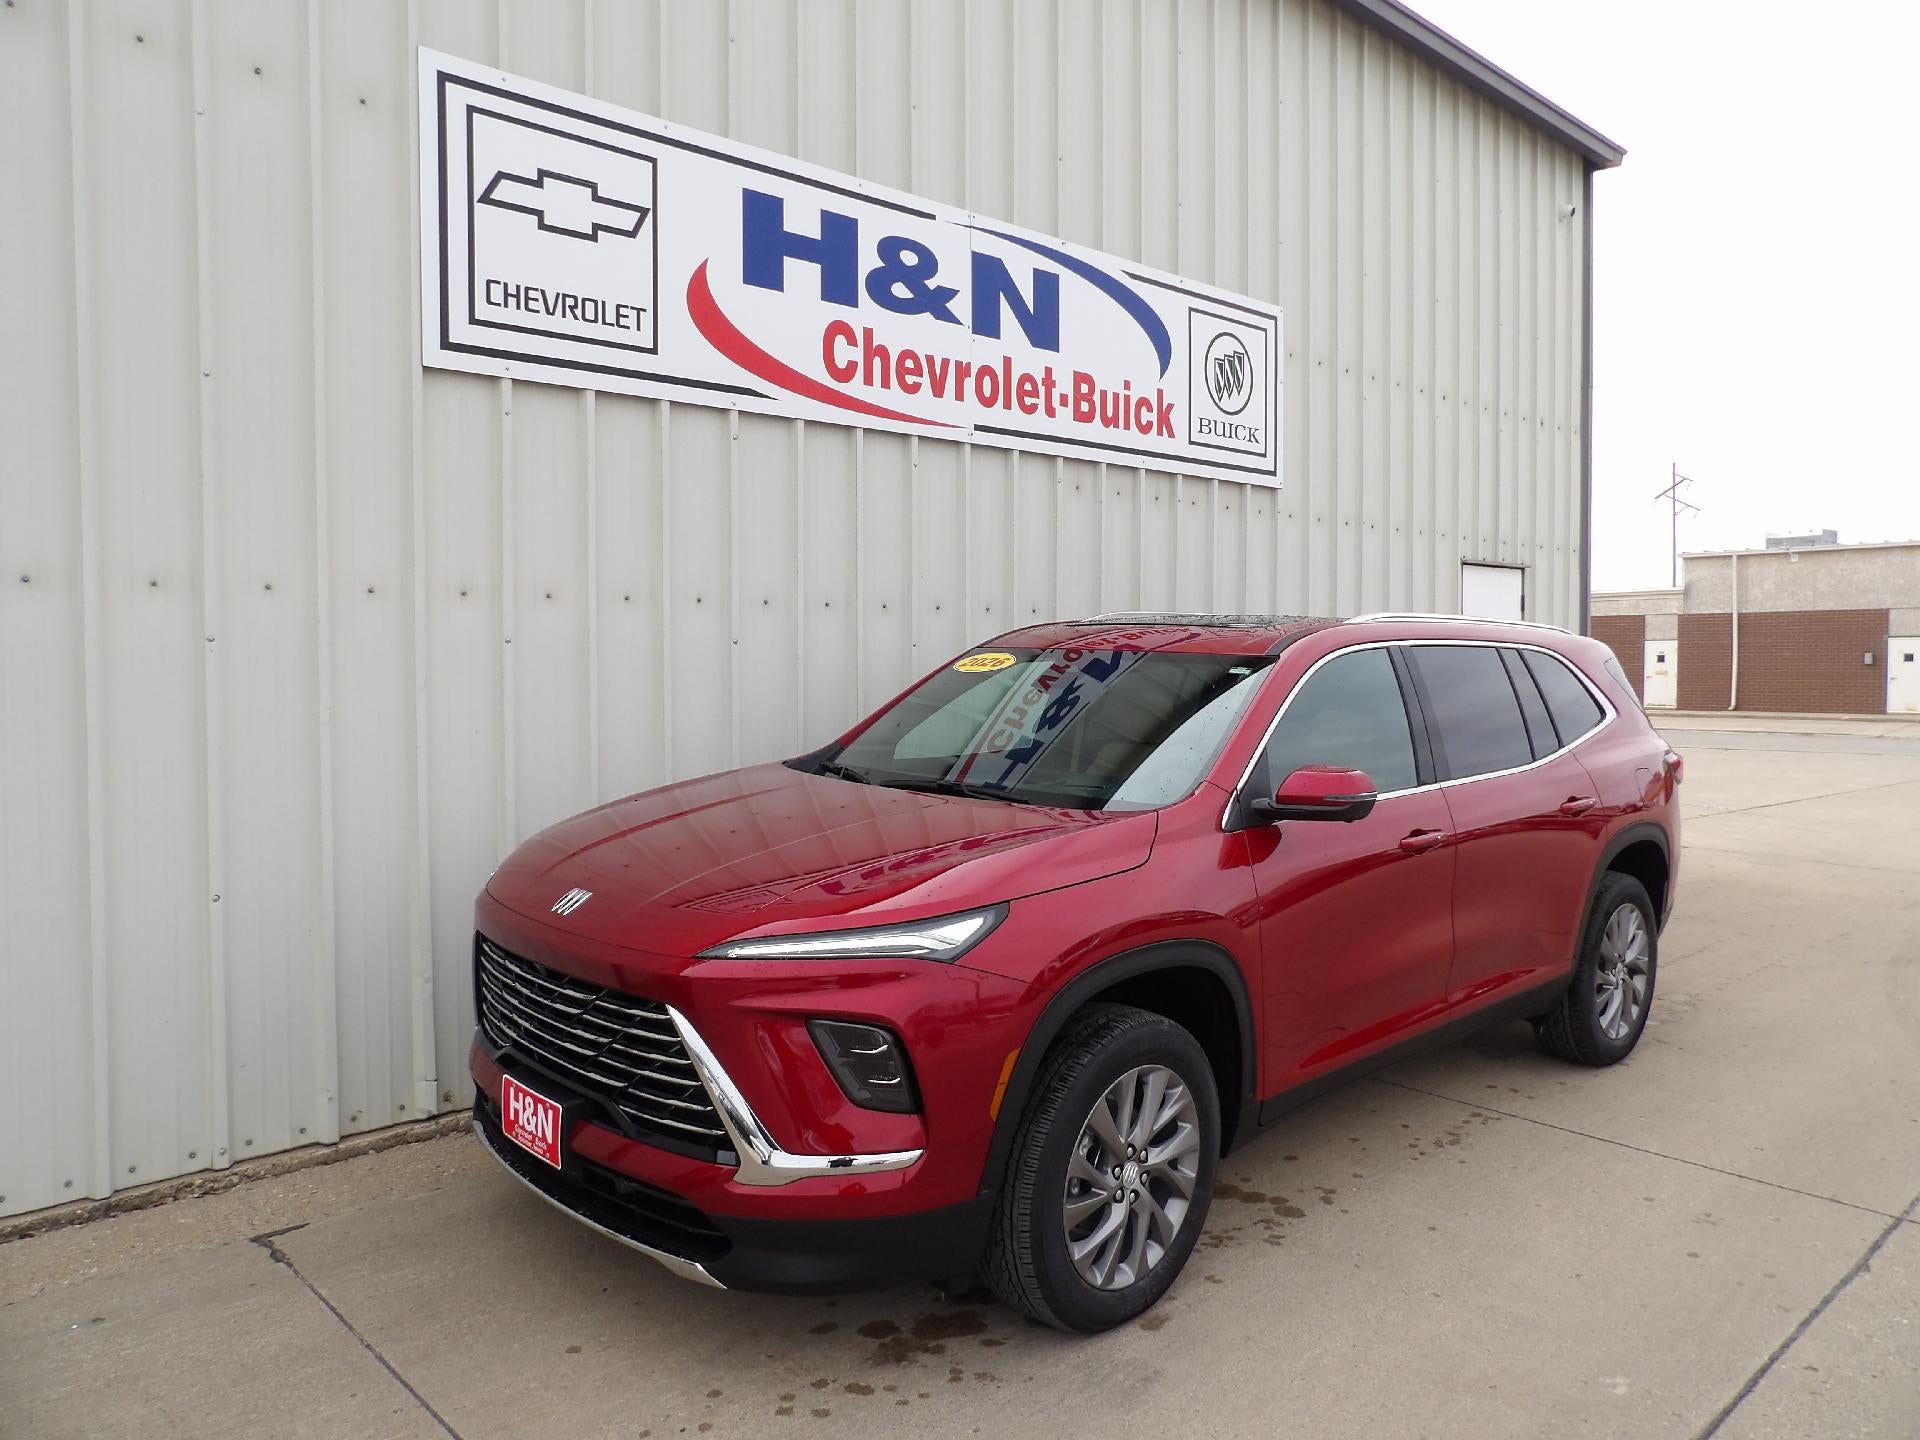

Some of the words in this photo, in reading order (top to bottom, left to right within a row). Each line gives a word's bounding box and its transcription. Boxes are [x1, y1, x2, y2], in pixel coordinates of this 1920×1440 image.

[741, 186, 1060, 353] H&N
[484, 279, 648, 332] CHEVROLET
[822, 319, 1176, 439] Chevrolet-Buick
[1196, 416, 1261, 444] BUICK
[509, 1086, 554, 1144] H&N
